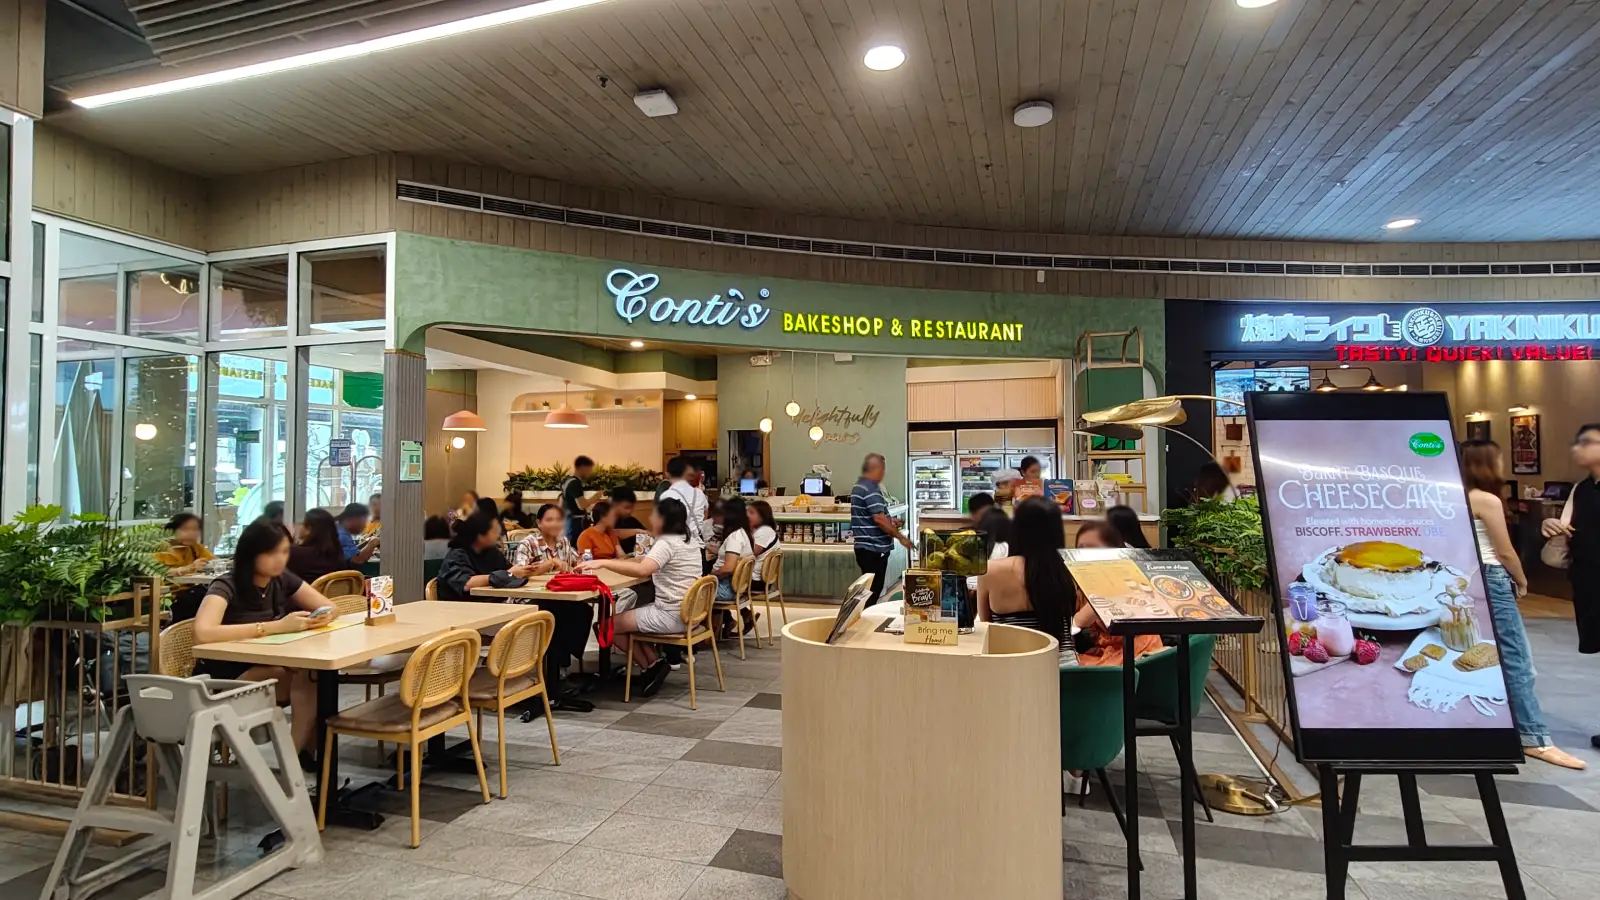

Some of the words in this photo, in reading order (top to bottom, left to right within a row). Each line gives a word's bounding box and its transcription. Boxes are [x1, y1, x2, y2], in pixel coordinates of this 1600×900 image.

[783, 312, 883, 336] BAKESHOP
[891, 318, 904, 337] &
[911, 319, 1024, 341] RESTAURANT
[1445, 314, 1600, 341] YAKINIKU
[1335, 345, 1416, 361] TASTY!
[1426, 345, 1503, 361] QUICK!
[1511, 345, 1592, 360] VALUE!
[1355, 465, 1425, 483] BASQUE
[1279, 479, 1455, 519] CHEESECAKE
[1306, 517, 1342, 525] Elevated
[1342, 517, 1359, 525] with
[1360, 517, 1406, 525] homemade
[1295, 527, 1343, 537] BISCOFF.
[1345, 527, 1421, 537] STRAWBERRY.
[1424, 527, 1446, 537] UBE
[918, 627, 937, 635] Bring
[925, 635, 946, 644] Home!
